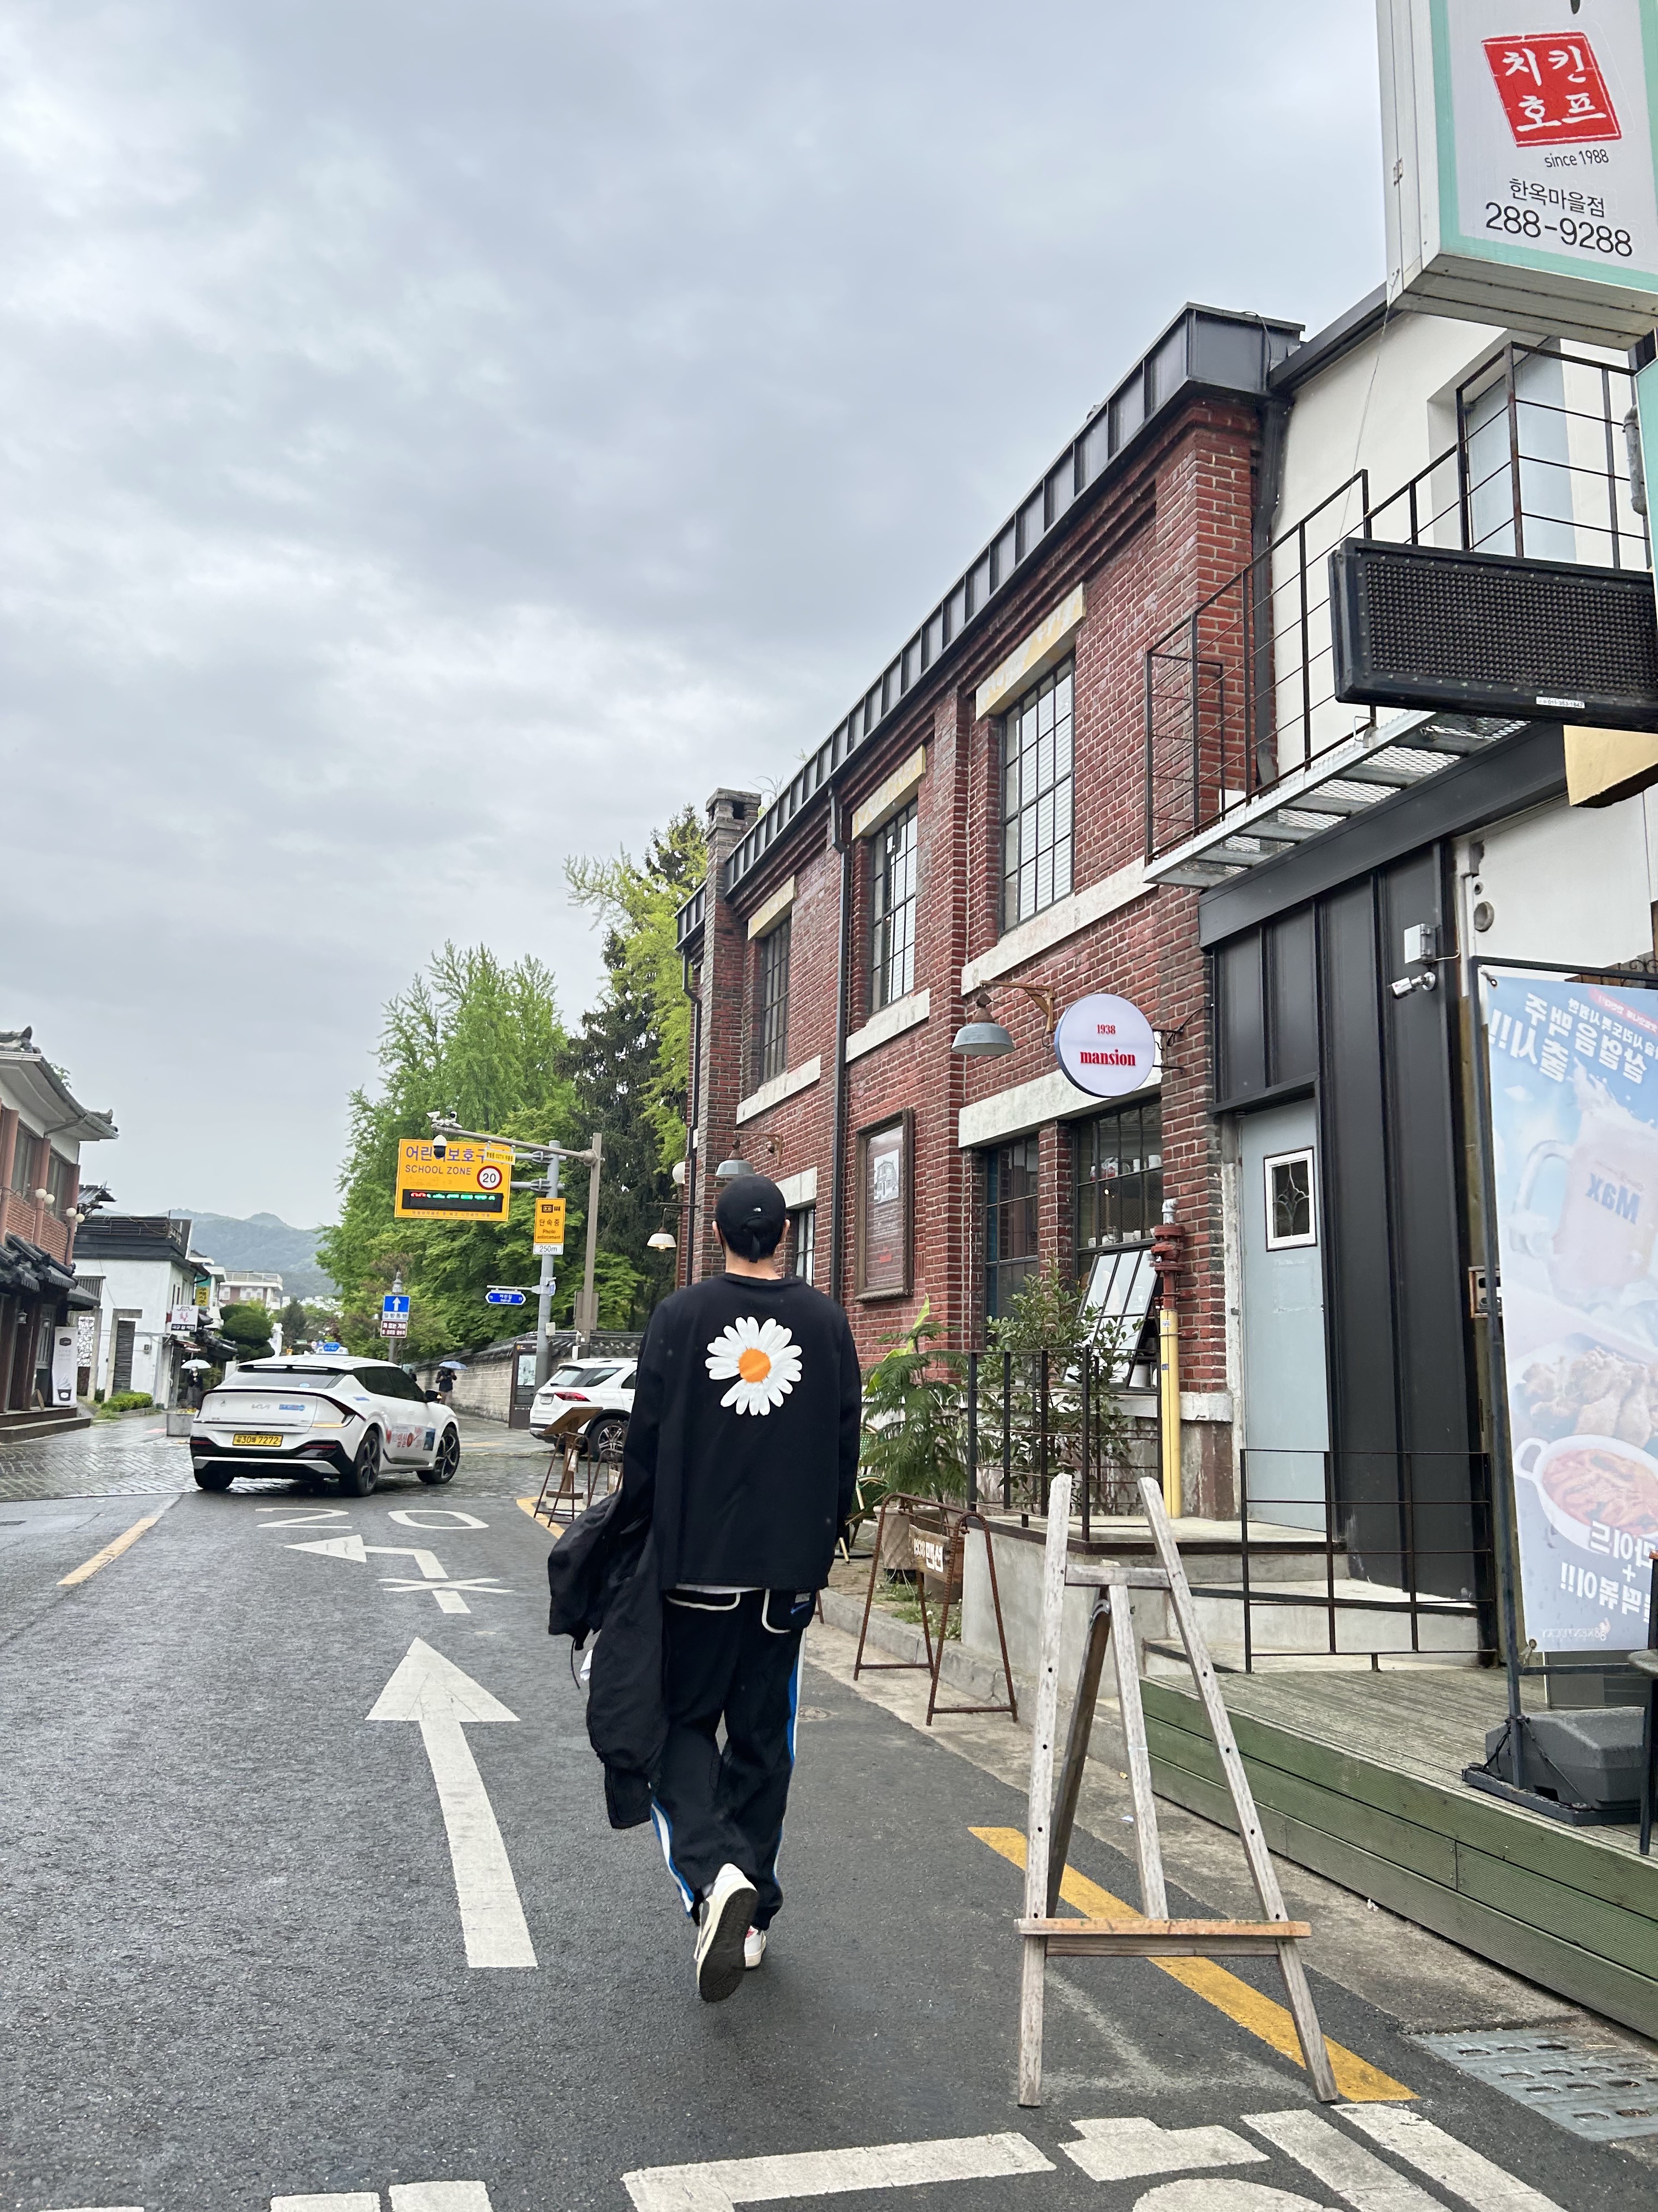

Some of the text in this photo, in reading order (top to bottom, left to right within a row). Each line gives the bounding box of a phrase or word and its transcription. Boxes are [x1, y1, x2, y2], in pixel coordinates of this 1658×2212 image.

[1502, 45, 1586, 87] 치킨
[1516, 92, 1607, 132] 호프
[1544, 149, 1609, 168] since 1988
[1509, 177, 1605, 218] 한옥마을점
[1485, 201, 1633, 257] 288-9288
[1096, 1024, 1116, 1035] 1938
[1080, 1048, 1136, 1066] mansion
[405, 1165, 472, 1175] SCHOOL ZONE
[482, 1173, 497, 1183] 20
[258, 1436, 279, 1444] 7272
[913, 1538, 926, 1558] 1938
